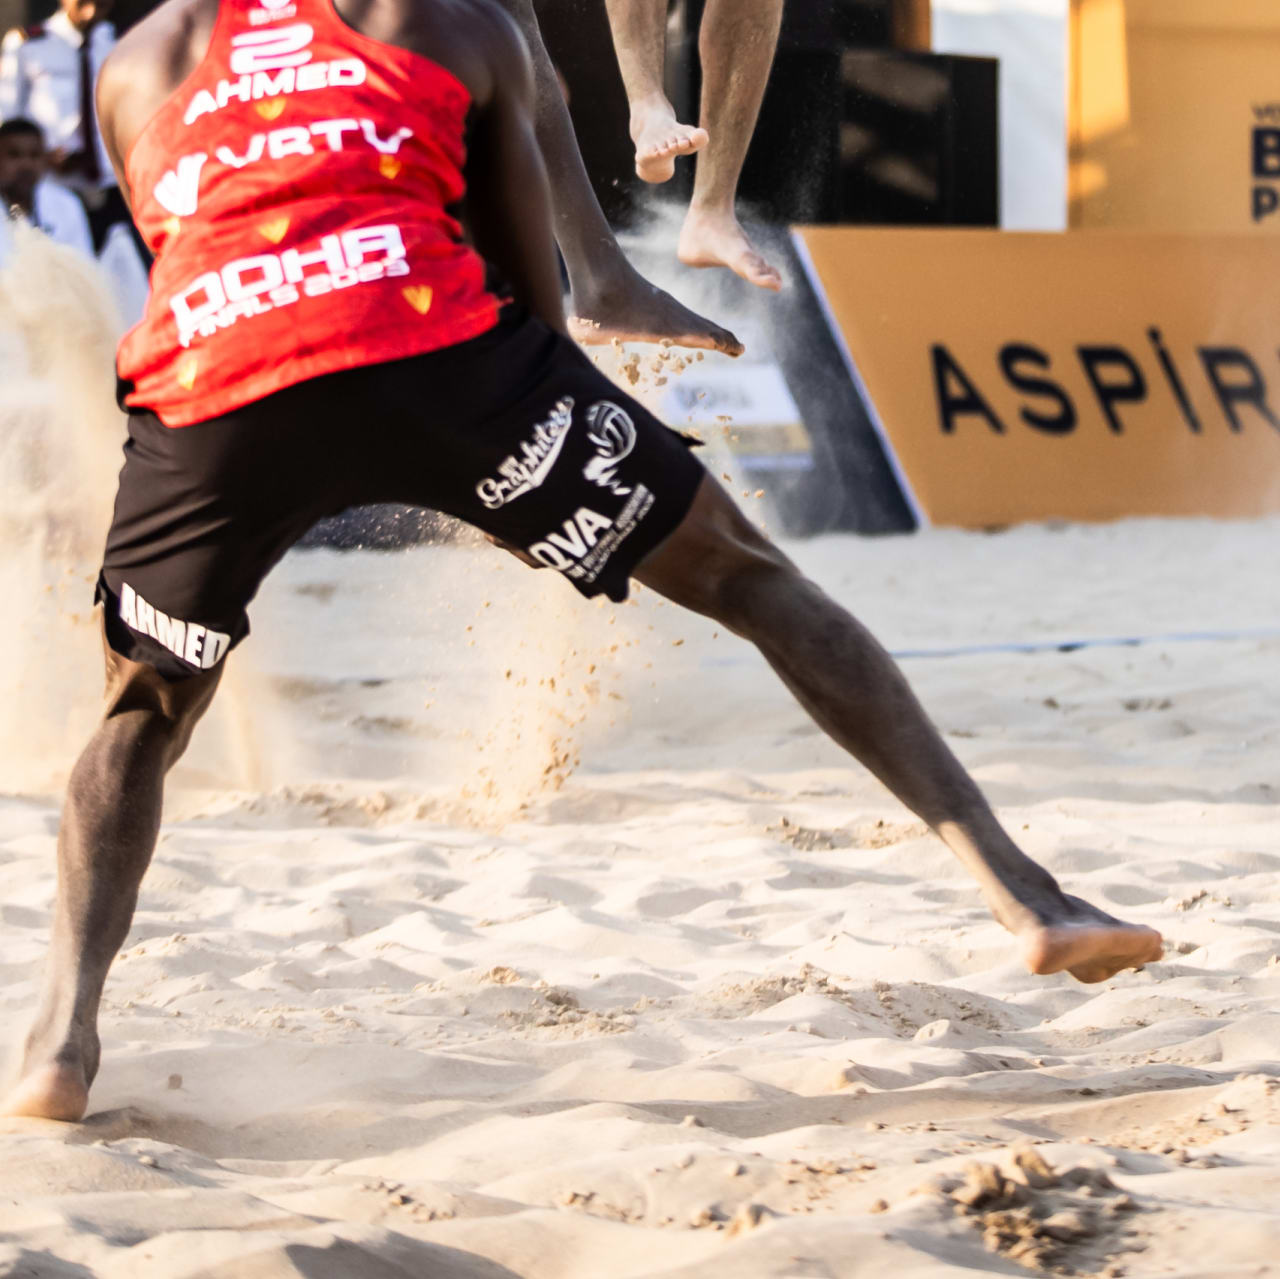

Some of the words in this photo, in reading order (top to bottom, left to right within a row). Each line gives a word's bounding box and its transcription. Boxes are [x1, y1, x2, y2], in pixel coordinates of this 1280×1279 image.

[230, 23, 314, 75] 2
[184, 57, 367, 125] AHMED
[170, 224, 406, 324] DOHA
[528, 506, 614, 571] QVA
[119, 581, 232, 670] AHMED
